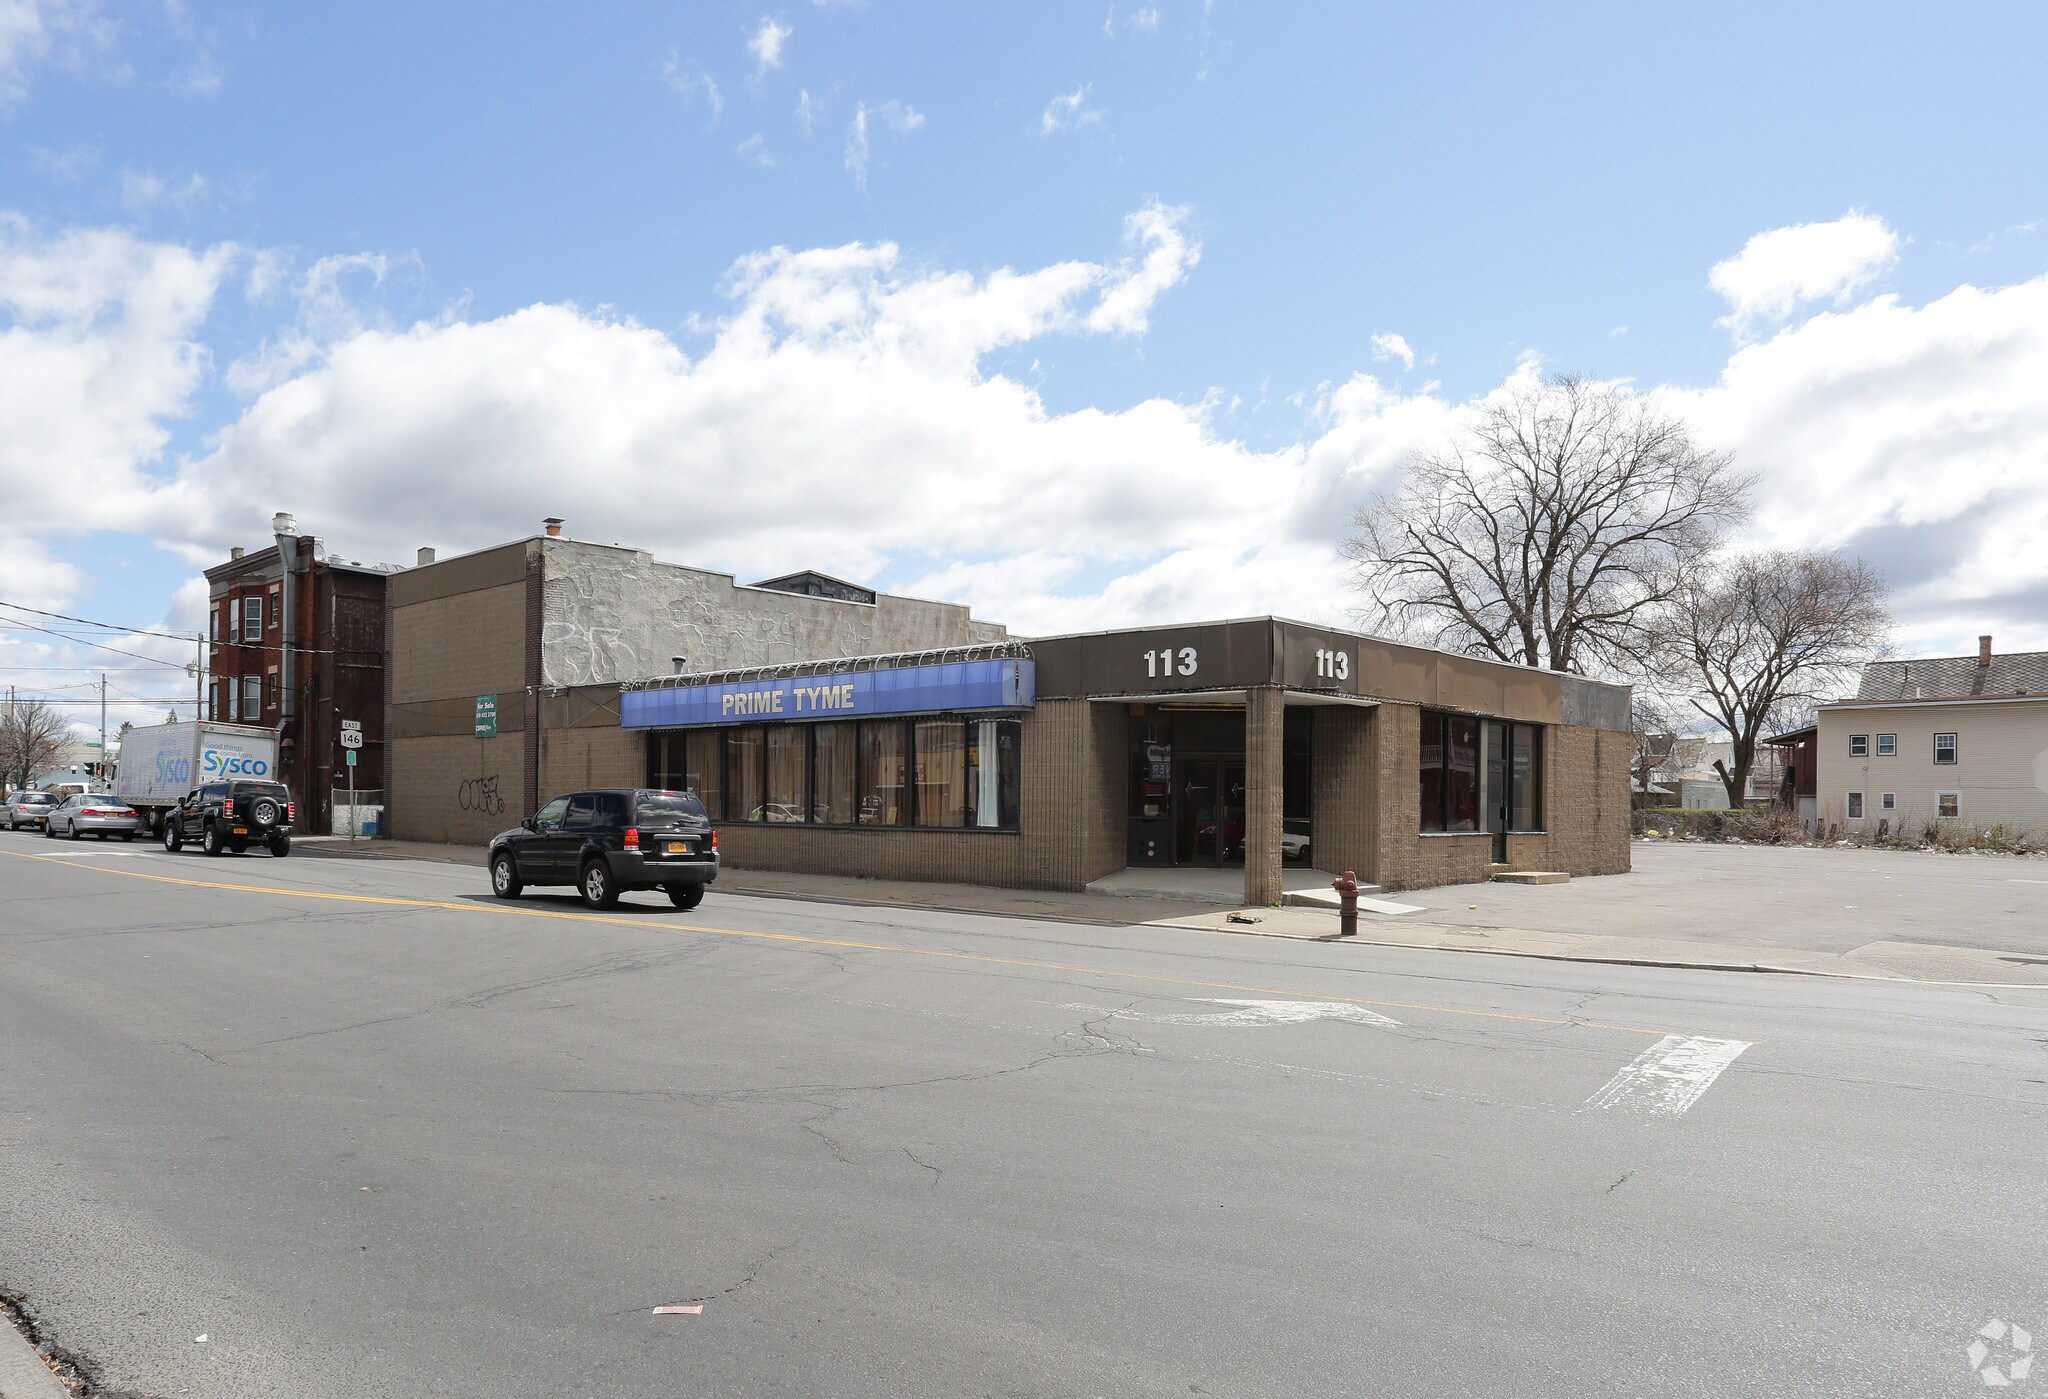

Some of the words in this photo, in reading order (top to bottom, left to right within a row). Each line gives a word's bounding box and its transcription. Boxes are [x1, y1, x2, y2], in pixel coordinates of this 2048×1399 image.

[1143, 647, 1198, 677] 113
[1315, 648, 1349, 681] 113
[722, 690, 784, 716] PRIME
[793, 684, 854, 711] TYME
[343, 734, 360, 744] 146
[344, 721, 358, 729] EAST
[205, 741, 223, 750] Good
[223, 743, 243, 752] things
[155, 750, 190, 791] Sysco
[203, 749, 268, 777] Sysco
